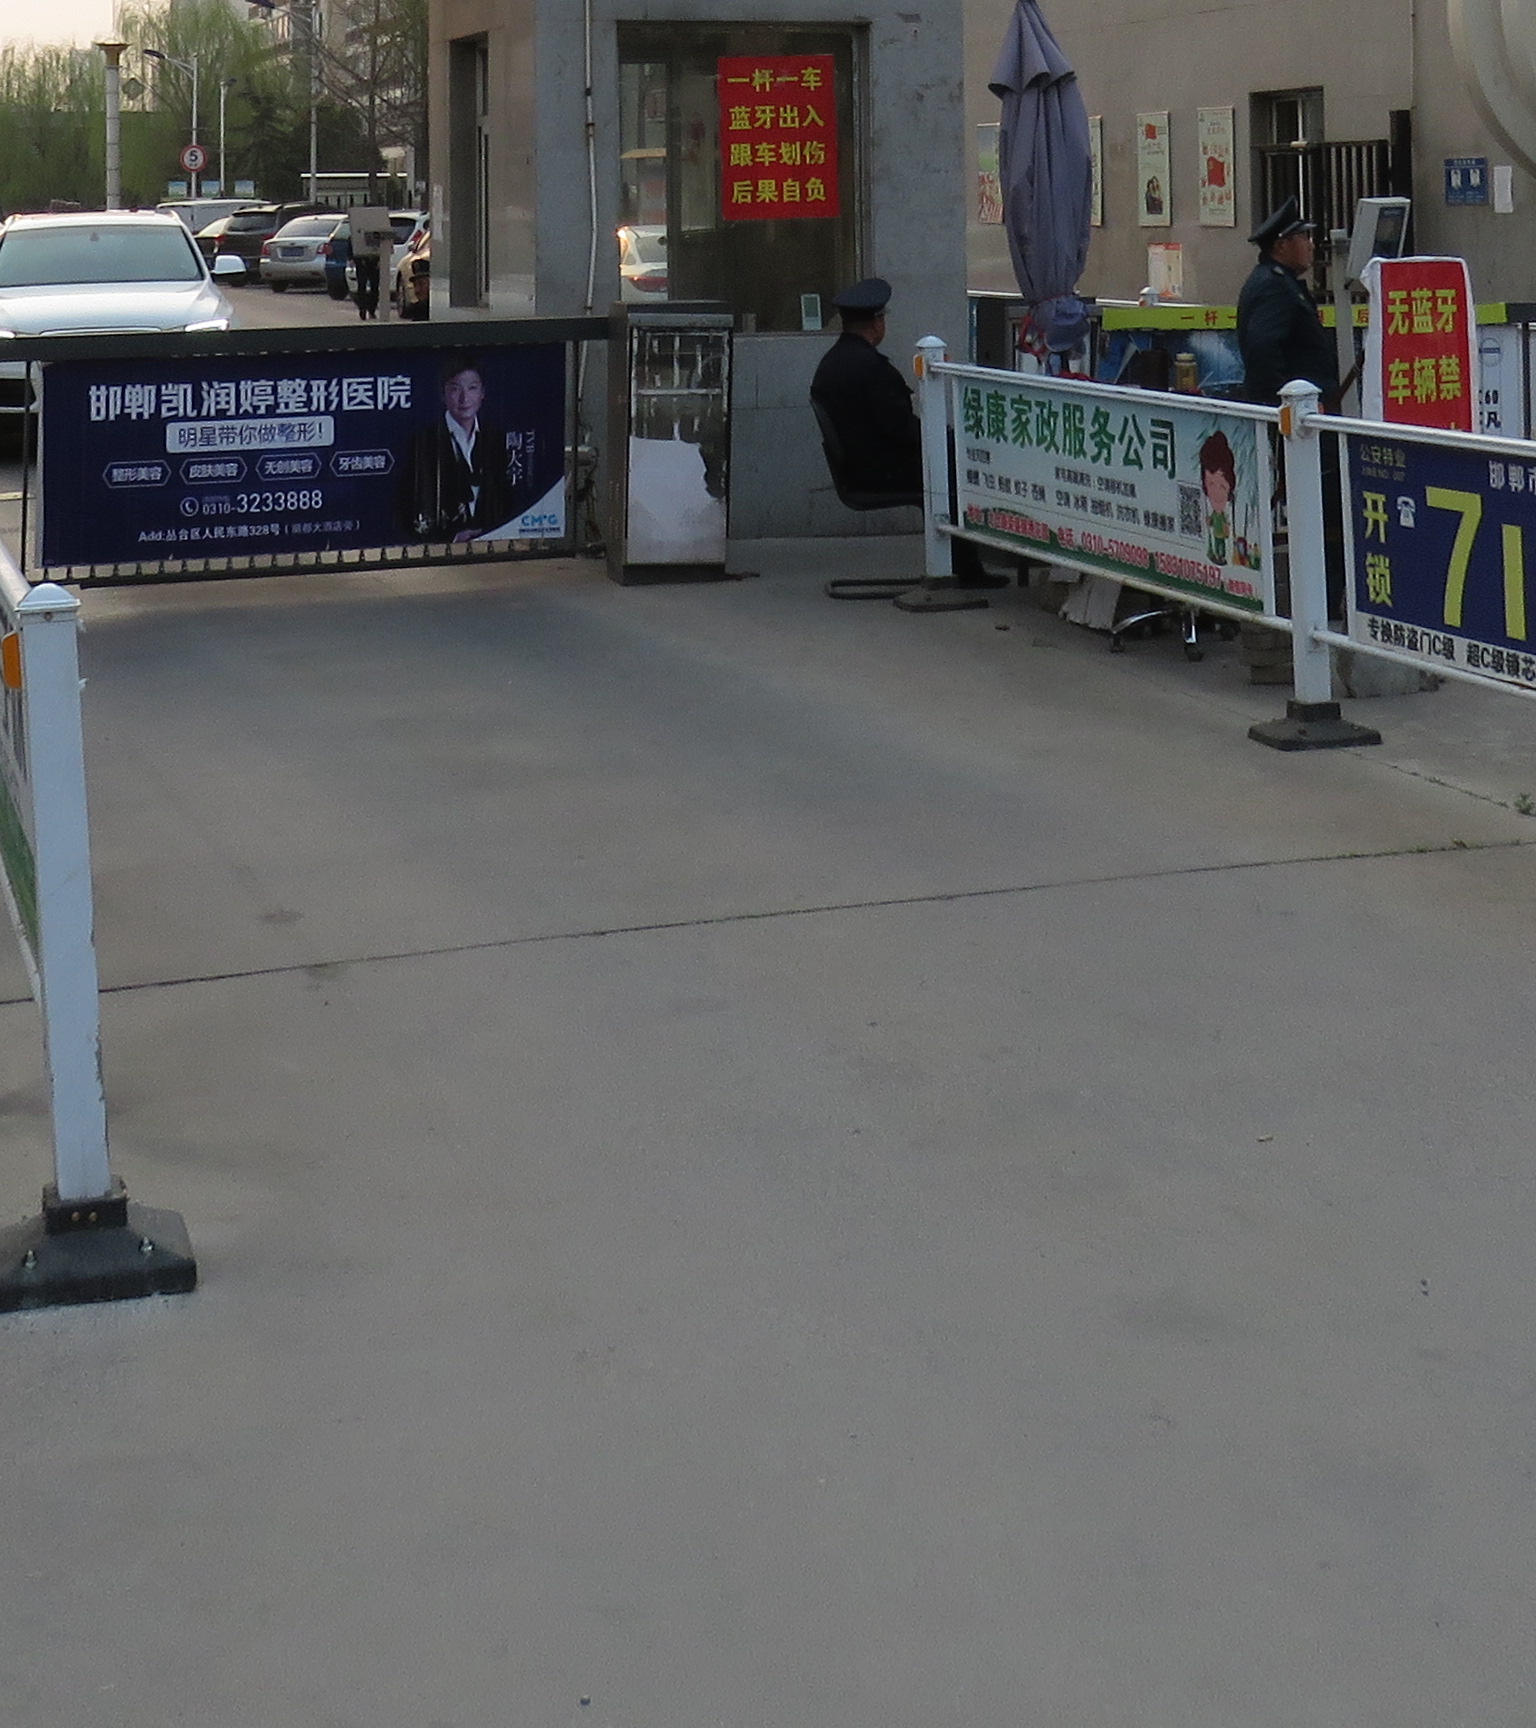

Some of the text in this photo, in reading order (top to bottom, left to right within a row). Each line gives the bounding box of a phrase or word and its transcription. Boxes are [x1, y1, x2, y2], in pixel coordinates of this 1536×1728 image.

[726, 66, 823, 92] 一杆一车
[728, 104, 825, 130] 蓝牙出入
[190, 149, 198, 162] 5
[729, 141, 826, 167] 跟车划伤
[731, 178, 827, 204] 后果自负
[1386, 286, 1457, 336] 无蓝牙
[1387, 354, 1462, 406] 车辆禁
[88, 374, 413, 422] 邯郸凯润婷整形医院
[963, 385, 1178, 480] 绿康家政服务公司
[111, 466, 163, 483] 整形美容
[188, 463, 239, 479] 皮肤美容
[201, 489, 324, 516] 0310-3233888
[1360, 489, 1395, 610] 开锁
[1366, 616, 1456, 663] 专换防盗门C级
